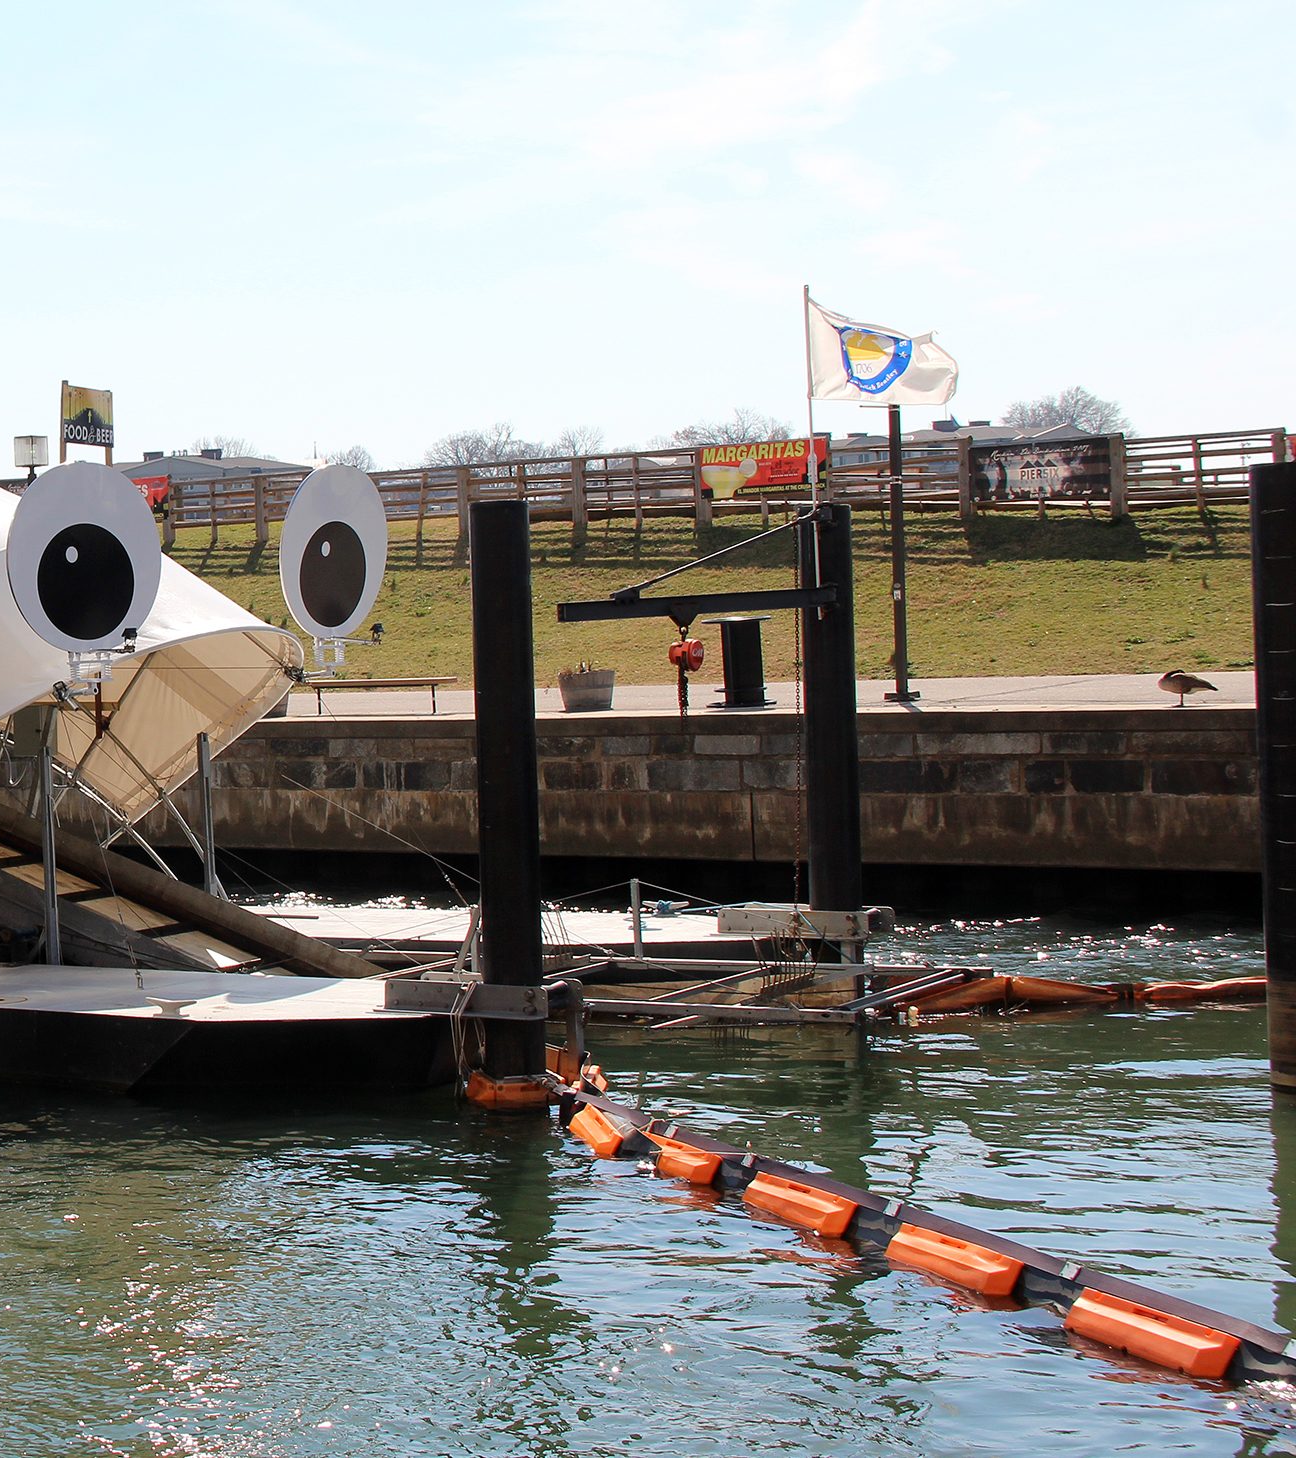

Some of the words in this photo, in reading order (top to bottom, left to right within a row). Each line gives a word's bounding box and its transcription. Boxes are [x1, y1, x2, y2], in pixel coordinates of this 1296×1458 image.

[64, 424, 88, 441] FOOD
[88, 425, 96, 444] &
[702, 441, 805, 464] MARGARITAS
[1020, 468, 1059, 481] PIERSIX
